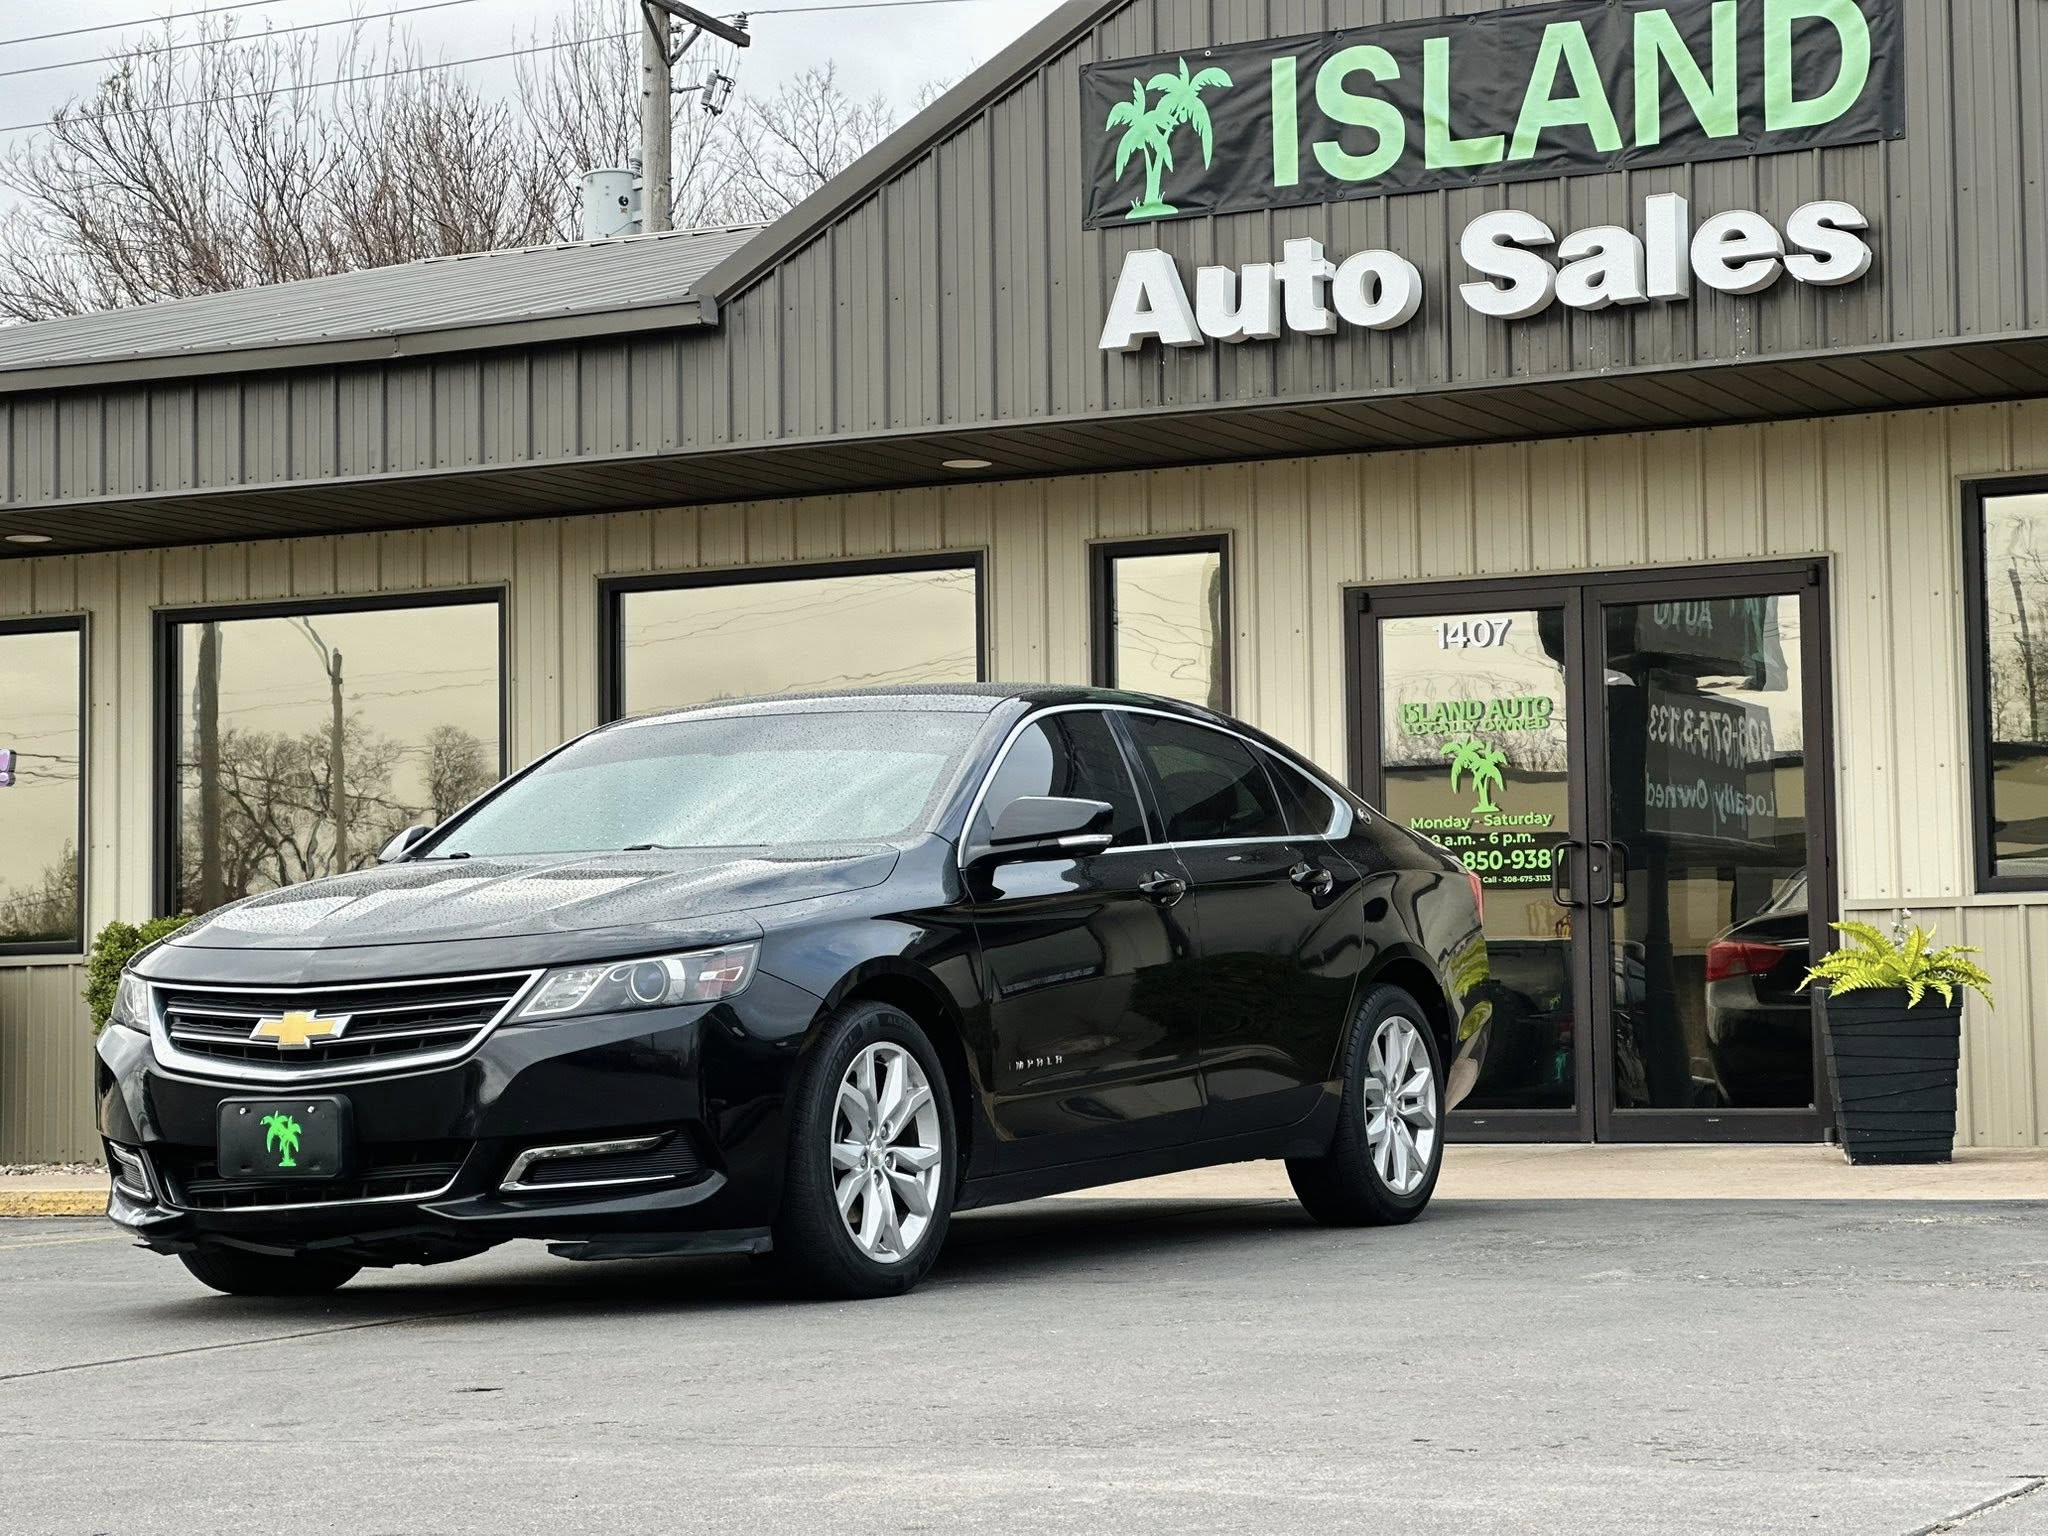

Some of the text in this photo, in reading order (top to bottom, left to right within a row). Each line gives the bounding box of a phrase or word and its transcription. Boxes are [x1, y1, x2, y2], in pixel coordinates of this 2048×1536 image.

[1271, 0, 1873, 187] ISLAND
[1098, 193, 1873, 352] Auto Sales
[1432, 618, 1512, 649] 1407
[1401, 696, 1553, 724] ISLAND AUTO
[1410, 815, 1471, 830] Monday
[1483, 812, 1552, 827] Saturday
[1444, 836, 1476, 846] a.m.
[1489, 833, 1499, 844] 6
[1502, 833, 1536, 847] p.m.
[1482, 876, 1498, 884] Call
[1008, 1055, 1063, 1071] IMPALA
